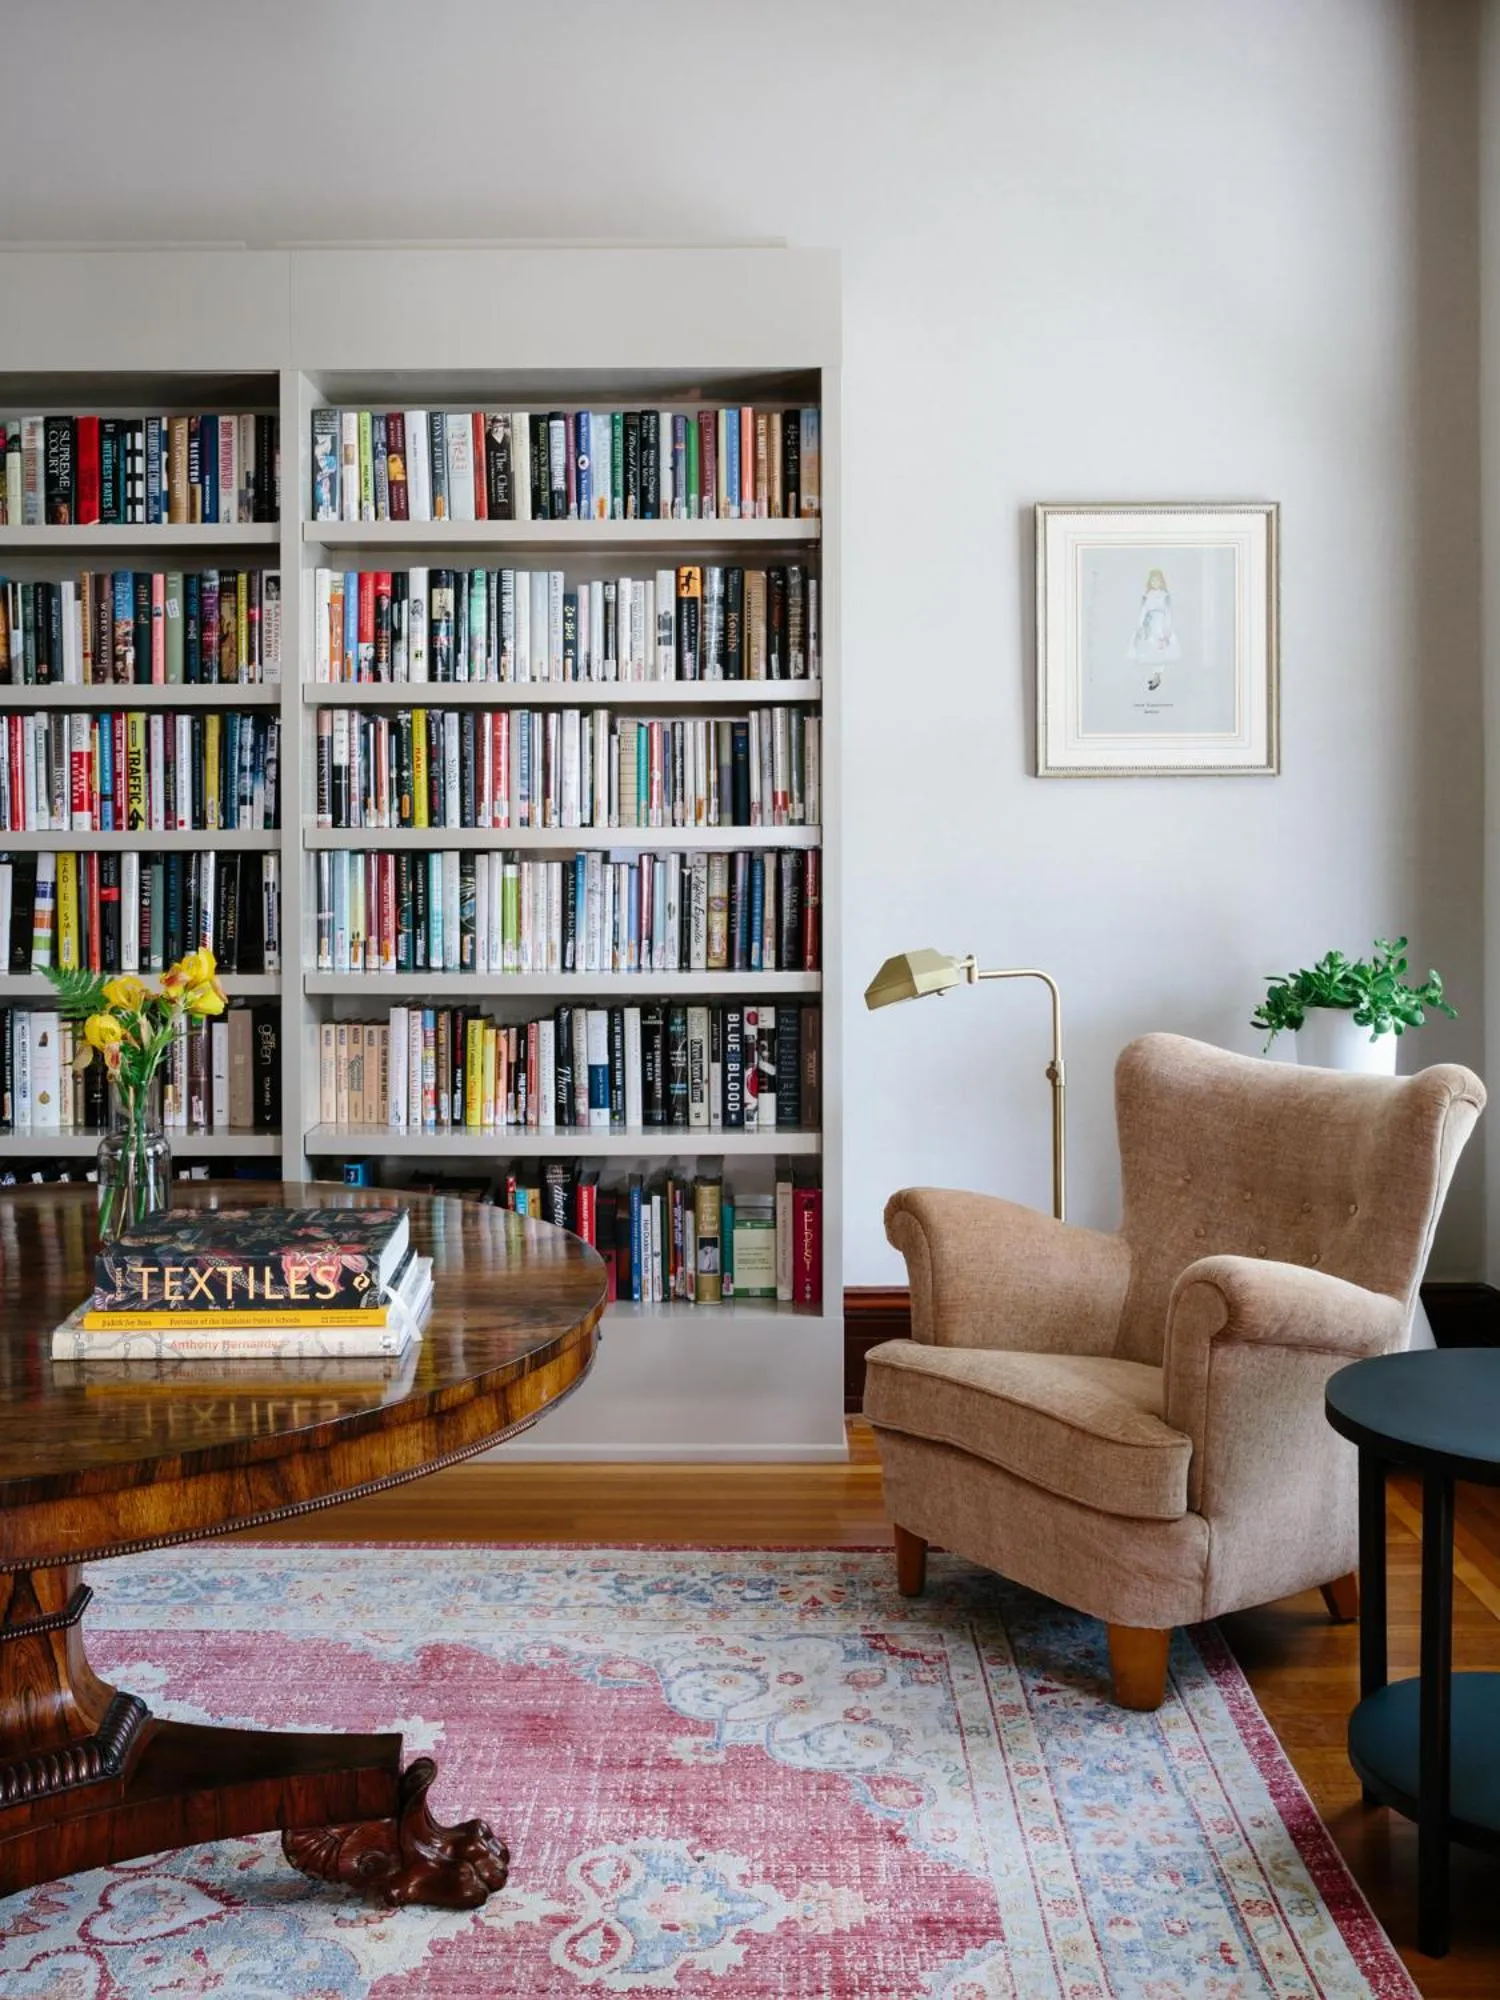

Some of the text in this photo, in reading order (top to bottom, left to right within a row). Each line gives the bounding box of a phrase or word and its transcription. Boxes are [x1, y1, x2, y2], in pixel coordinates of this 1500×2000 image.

[434, 415, 443, 474] TONY JUDT
[642, 416, 650, 438] Pollan
[649, 416, 657, 444] Michael
[49, 430, 60, 477] COURT
[59, 430, 70, 488] SUPREME
[103, 440, 113, 509] INTEREST RATES
[190, 442, 200, 483] MAESTRO
[496, 449, 509, 504] The Chief
[649, 467, 656, 475] to
[642, 467, 650, 487] Mind
[647, 477, 657, 504] Change
[101, 602, 109, 664] WORD VIRUS
[265, 608, 273, 658] HEPBURN
[129, 749, 142, 805] TRAFFIC
[417, 861, 425, 894] JENNIFER
[227, 895, 236, 940] SNOWBALL
[568, 873, 576, 942] ALICE MUN
[692, 876, 706, 946] Jeffrey Eugenides
[647, 1052, 653, 1061] IS
[654, 1050, 662, 1098] SINGULARITY
[728, 1013, 741, 1111] BLUE BLOOD
[557, 1066, 572, 1104] Them
[132, 1266, 337, 1301] TEXTILES
[171, 1338, 218, 1351] Anthony
